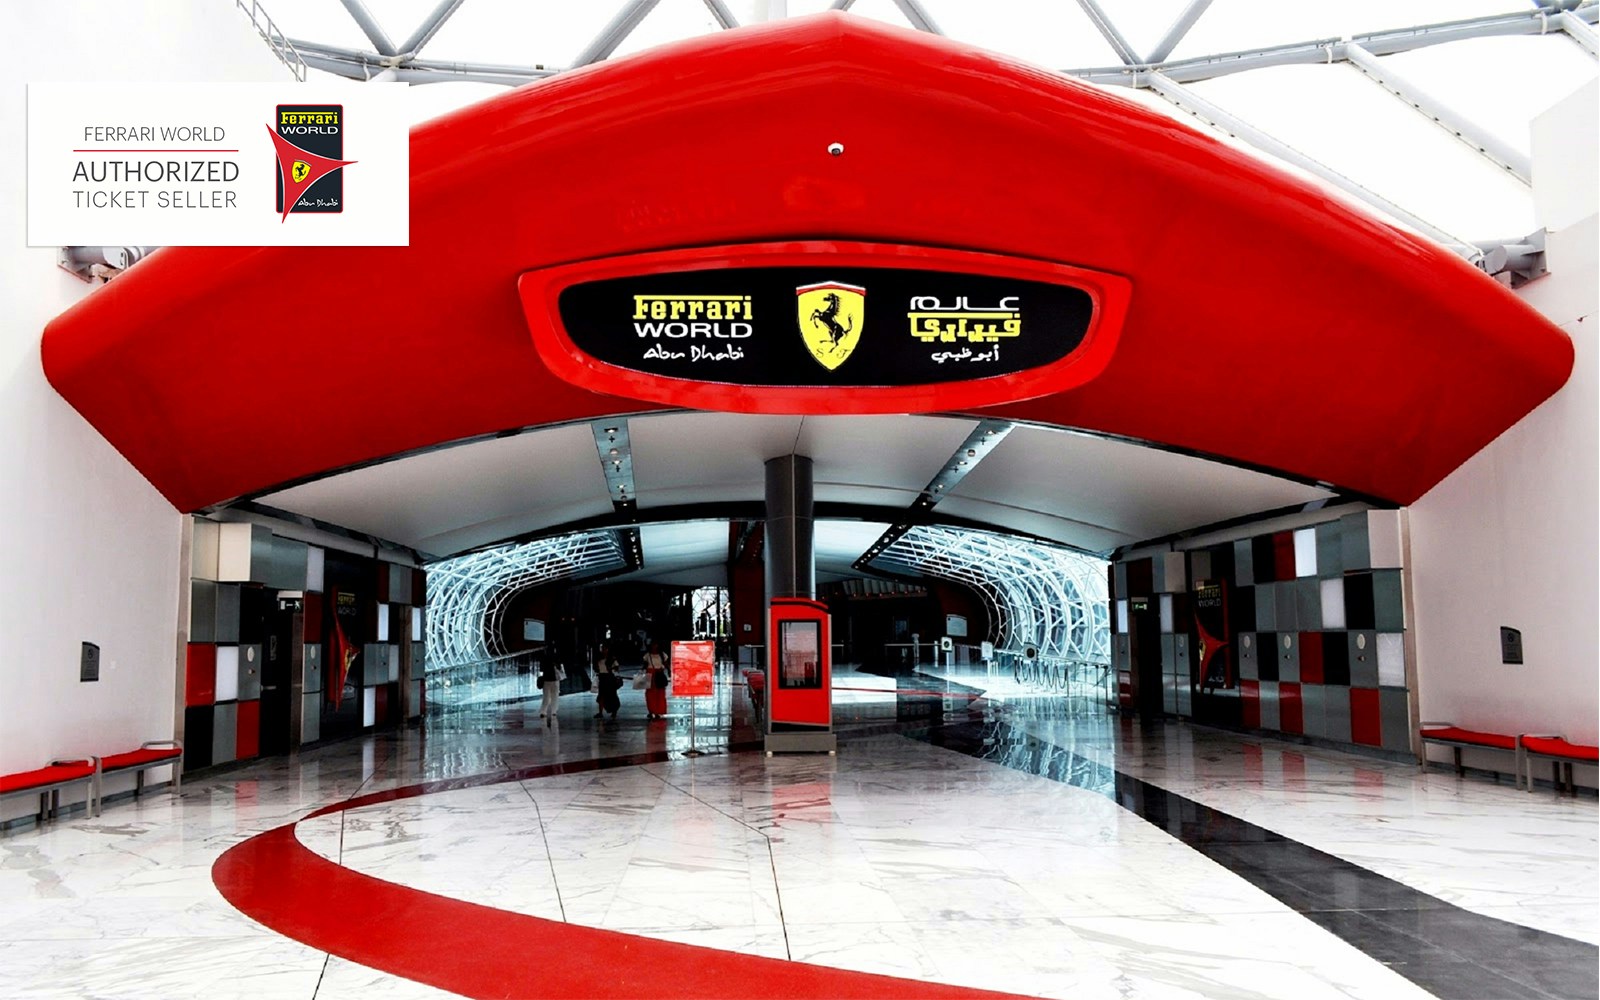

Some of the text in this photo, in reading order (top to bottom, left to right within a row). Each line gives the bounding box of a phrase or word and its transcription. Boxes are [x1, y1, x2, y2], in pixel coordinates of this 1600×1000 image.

[632, 295, 753, 320] Ferrari
[910, 296, 1020, 311] عالم
[633, 323, 753, 338] WORLD
[907, 312, 1022, 343] فيراري
[643, 344, 744, 362] Abu Dhabi
[1198, 598, 1222, 608] WORLD
